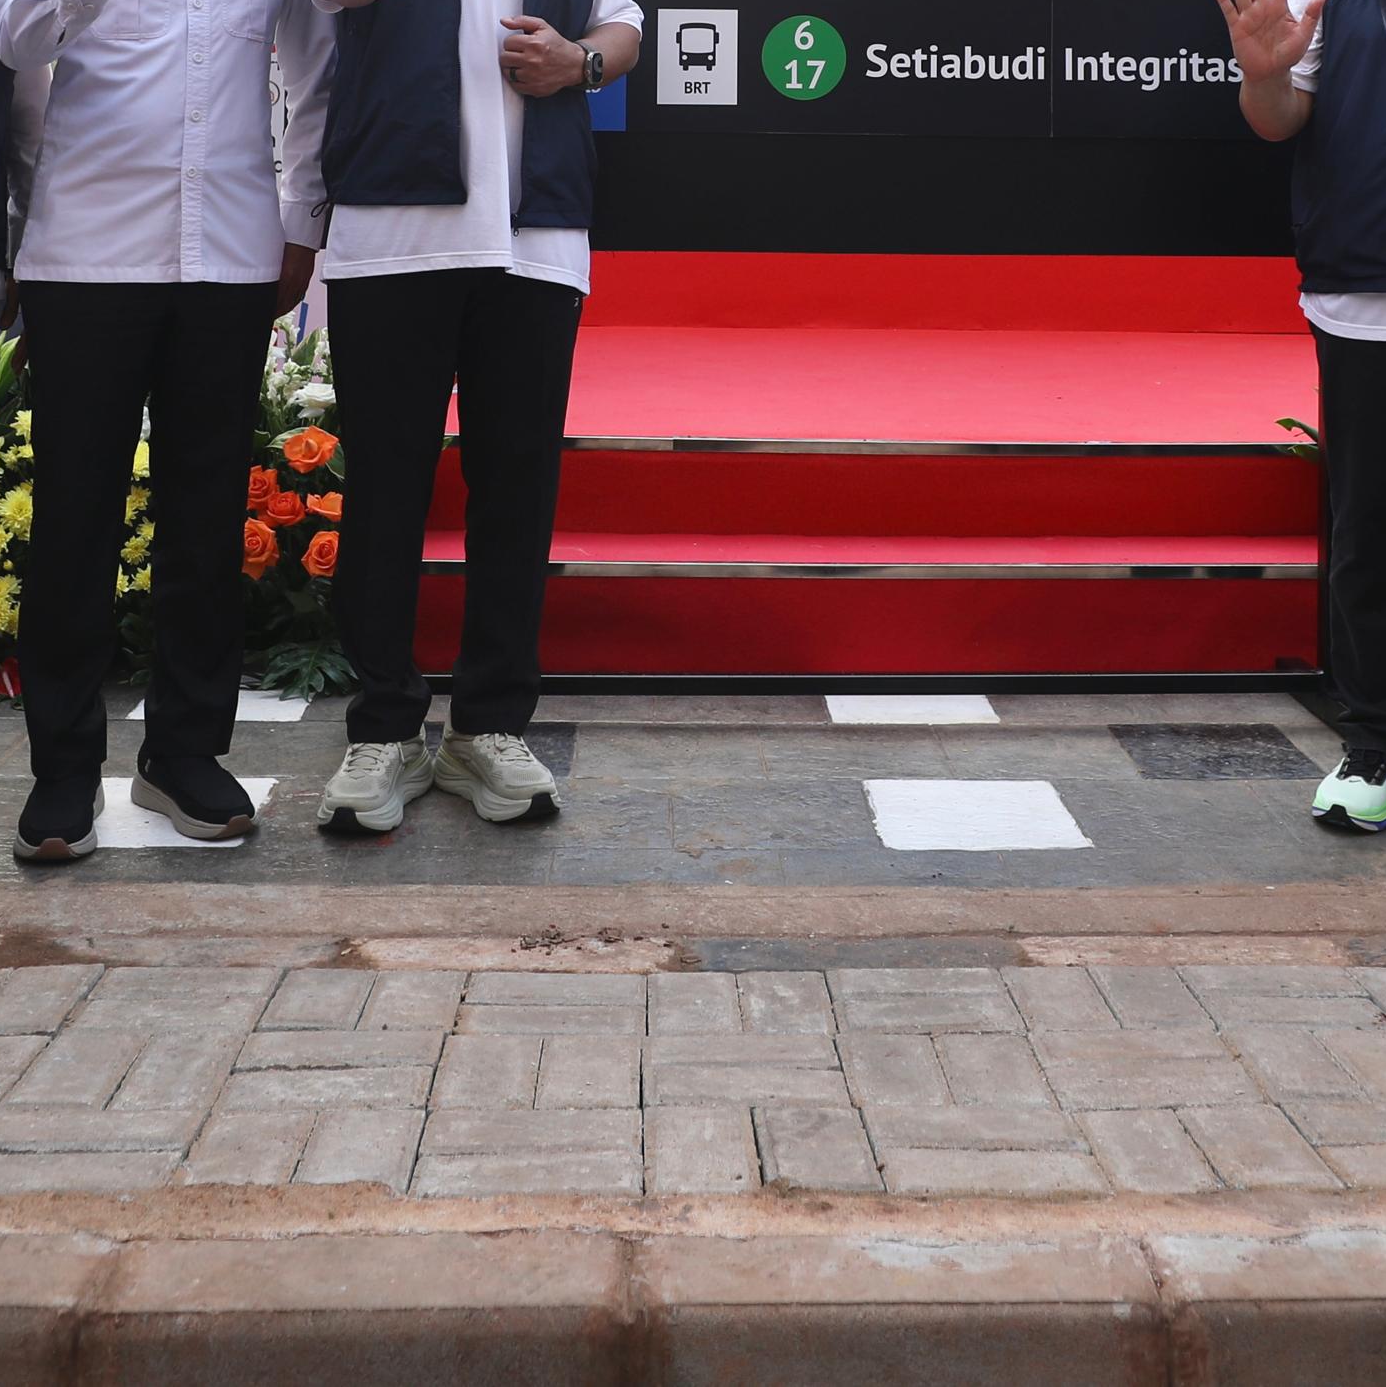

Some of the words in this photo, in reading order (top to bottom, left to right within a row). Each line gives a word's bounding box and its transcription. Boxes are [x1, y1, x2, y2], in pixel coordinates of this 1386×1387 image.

[794, 20, 815, 50] 6
[784, 59, 827, 89] 17
[865, 43, 1046, 80] Setiabudi
[684, 81, 712, 95] BRT
